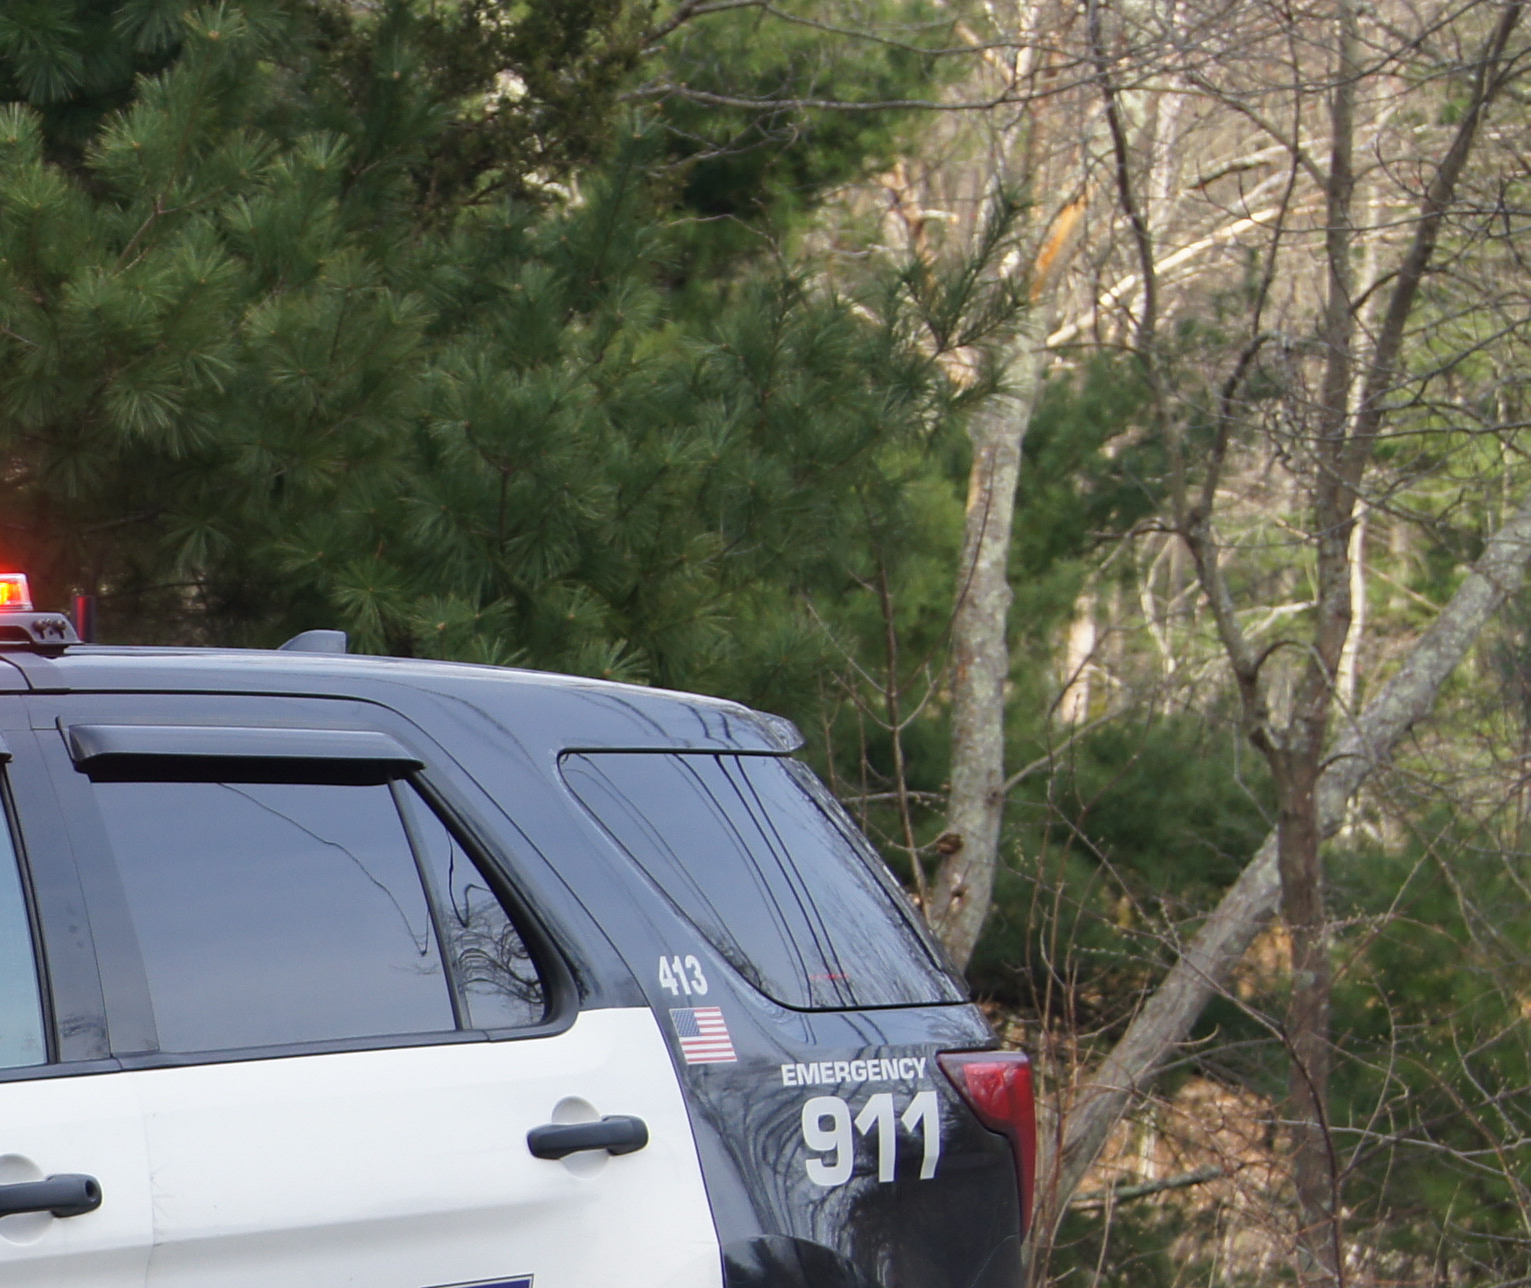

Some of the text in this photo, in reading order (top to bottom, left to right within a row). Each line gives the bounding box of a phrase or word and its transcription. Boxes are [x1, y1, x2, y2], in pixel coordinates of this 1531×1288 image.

[658, 955, 708, 996] 413
[780, 1057, 926, 1086] EMERGENCY
[801, 1091, 940, 1186] 911
